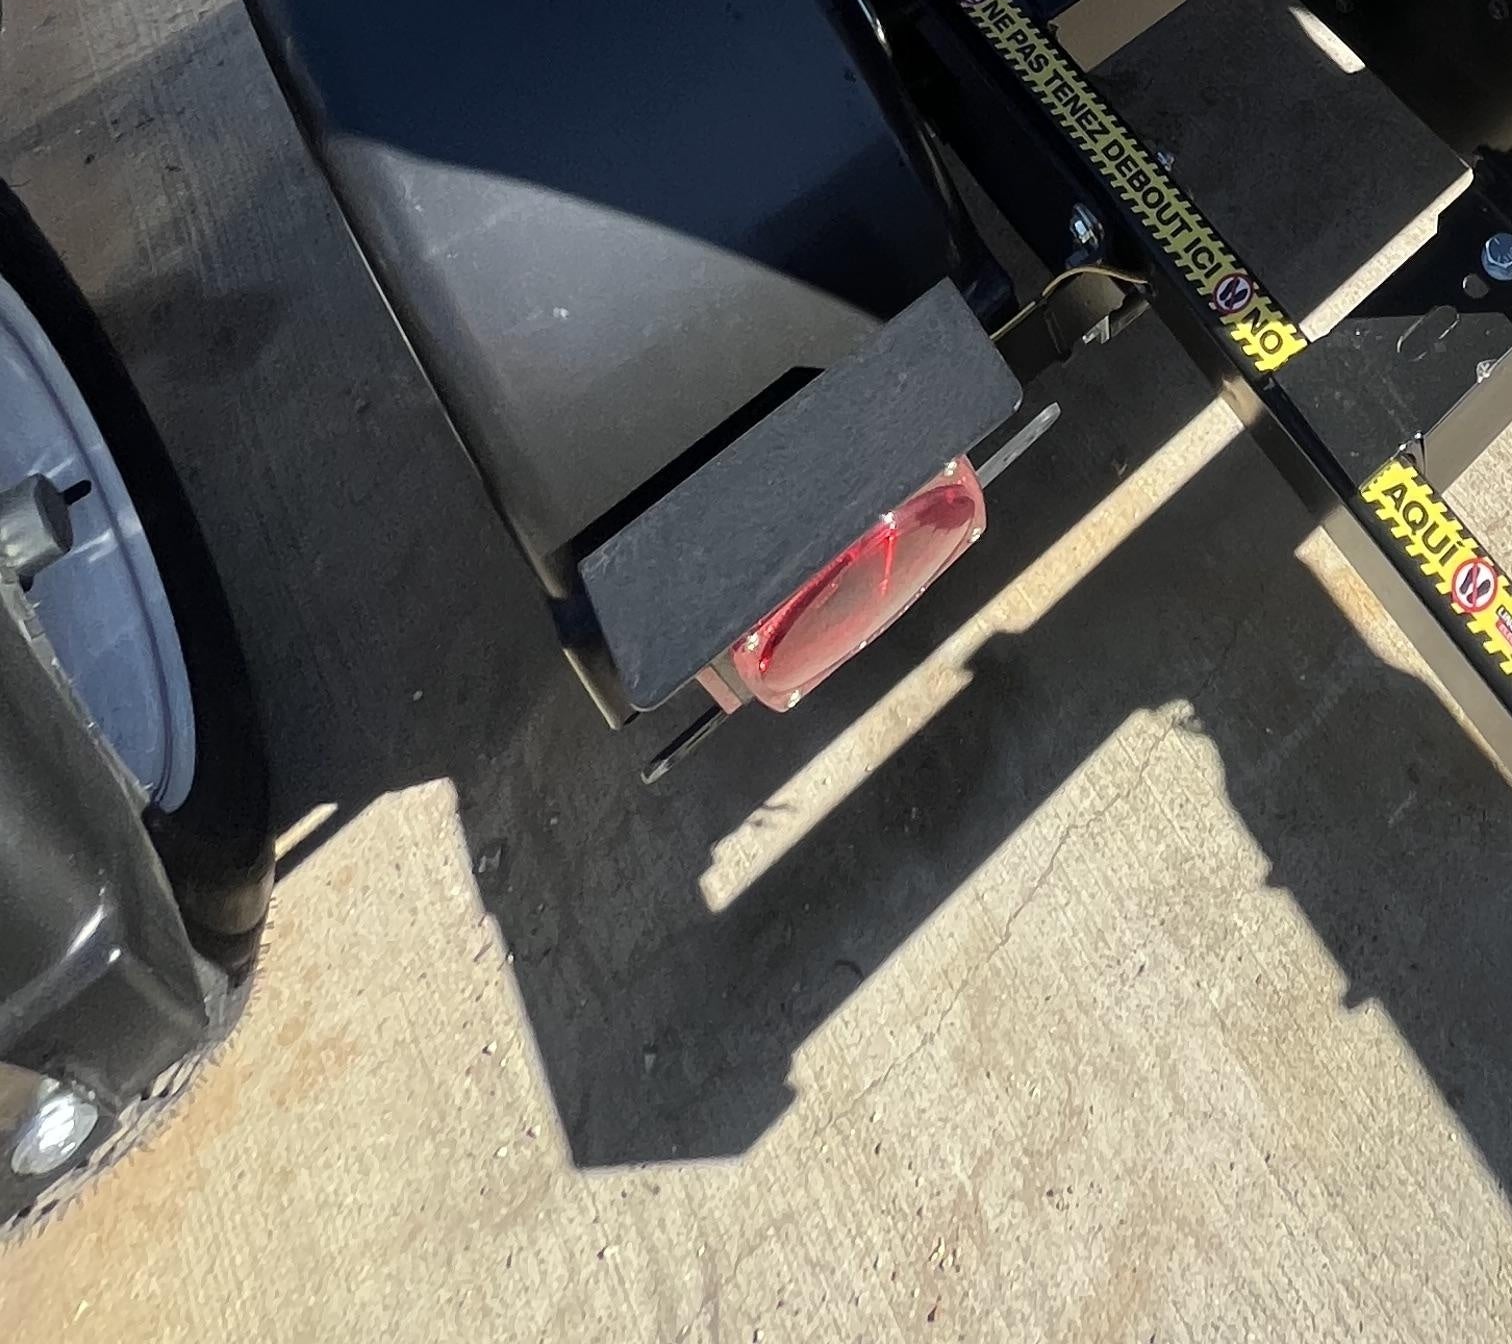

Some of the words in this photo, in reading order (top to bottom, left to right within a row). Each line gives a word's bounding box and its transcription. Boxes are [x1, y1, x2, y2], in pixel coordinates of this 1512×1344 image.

[986, 2, 1012, 35] NE
[1007, 29, 1049, 73] PAS
[1042, 70, 1111, 144] TENEZ
[1101, 139, 1188, 240] DEBOUT
[1184, 238, 1222, 278] ICI
[1241, 308, 1283, 354] NO
